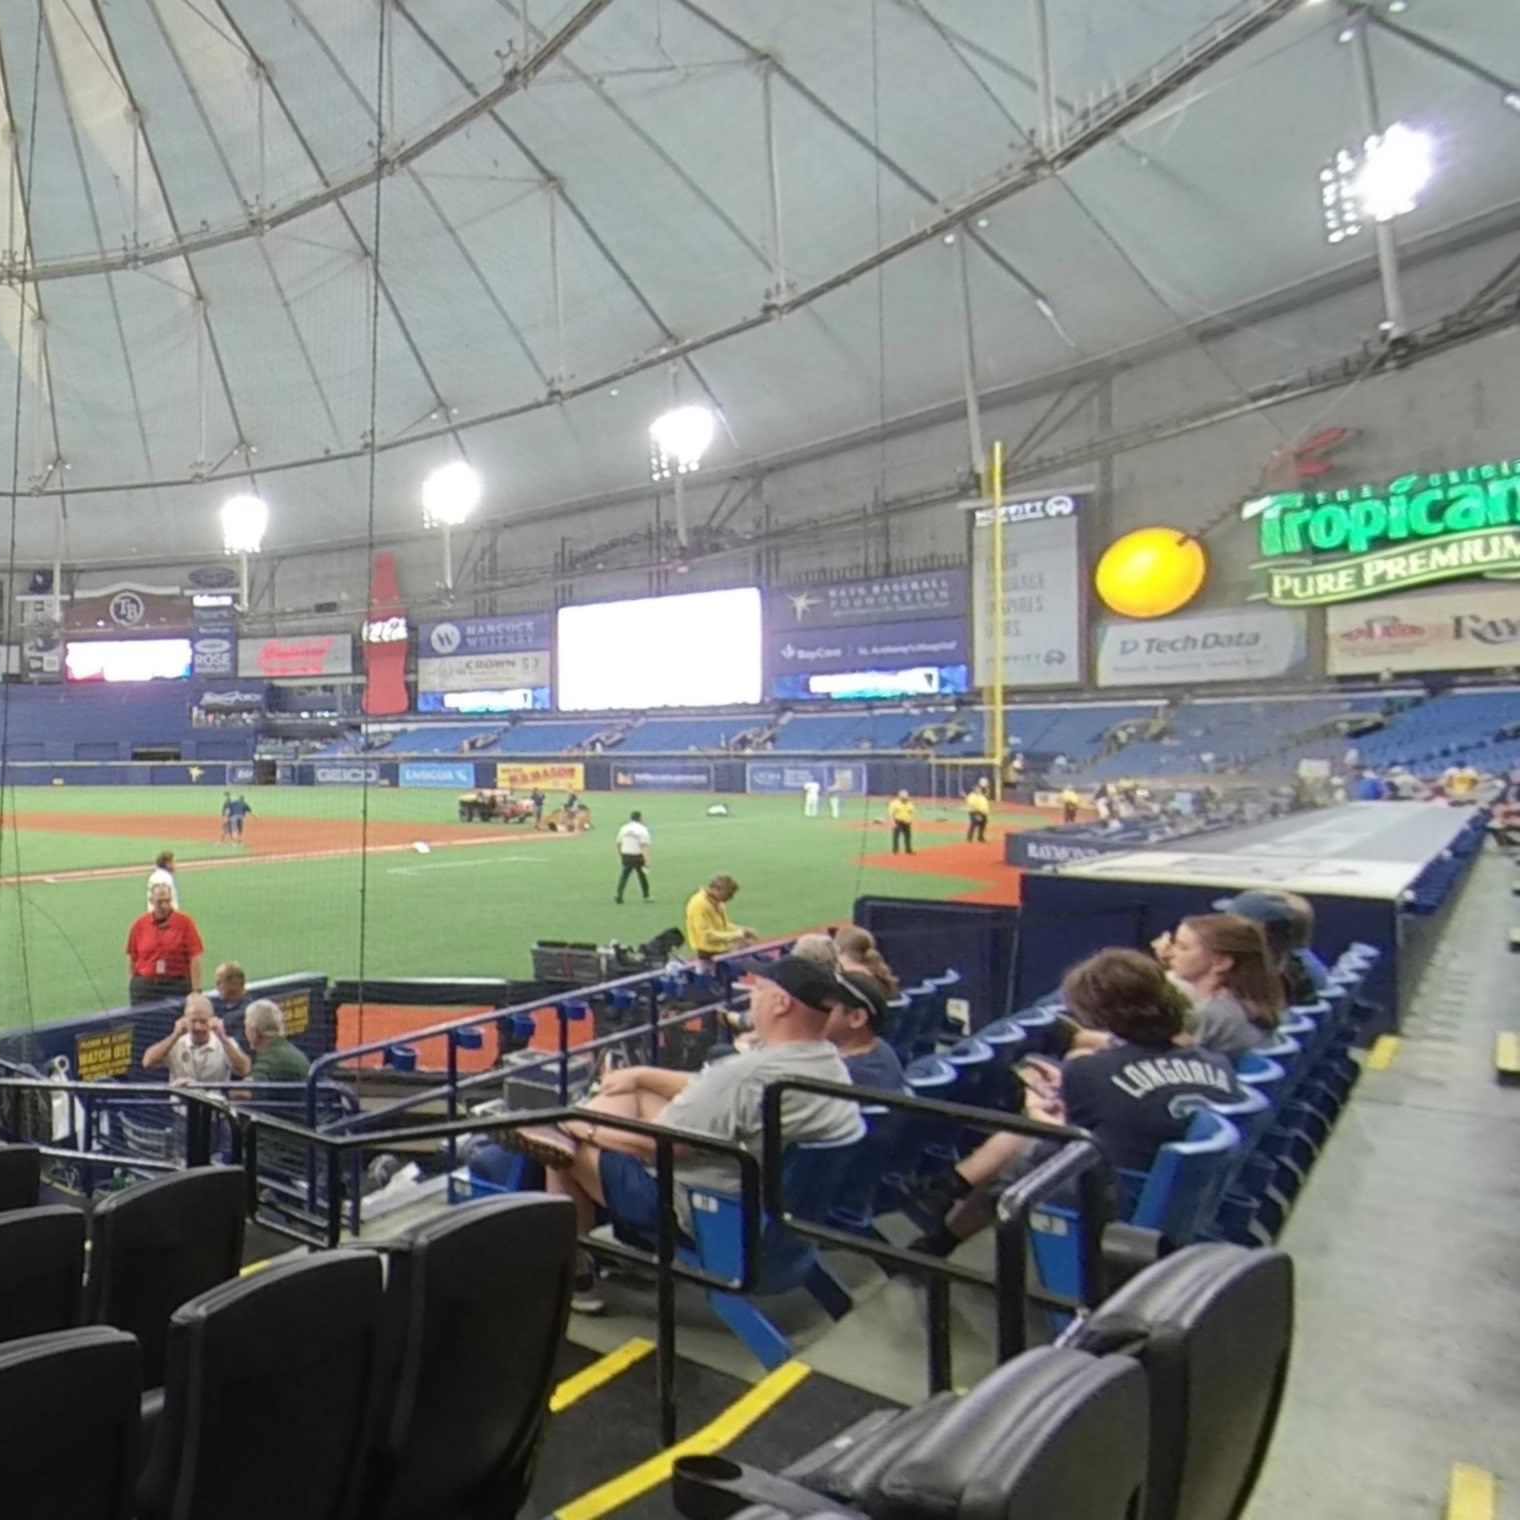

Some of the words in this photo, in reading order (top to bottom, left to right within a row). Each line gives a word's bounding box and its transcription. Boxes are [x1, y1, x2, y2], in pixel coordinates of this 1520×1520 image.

[1272, 567, 1357, 598] PURE
[466, 621, 535, 635] HANCOCK
[466, 634, 534, 647] WHITNEY
[1143, 635, 1199, 654] Tech
[1201, 631, 1262, 650] Data
[194, 651, 231, 667] ROSE
[465, 659, 516, 669] CROWN
[317, 767, 377, 782] GEICO
[1111, 1057, 1231, 1099] LONGORIA
